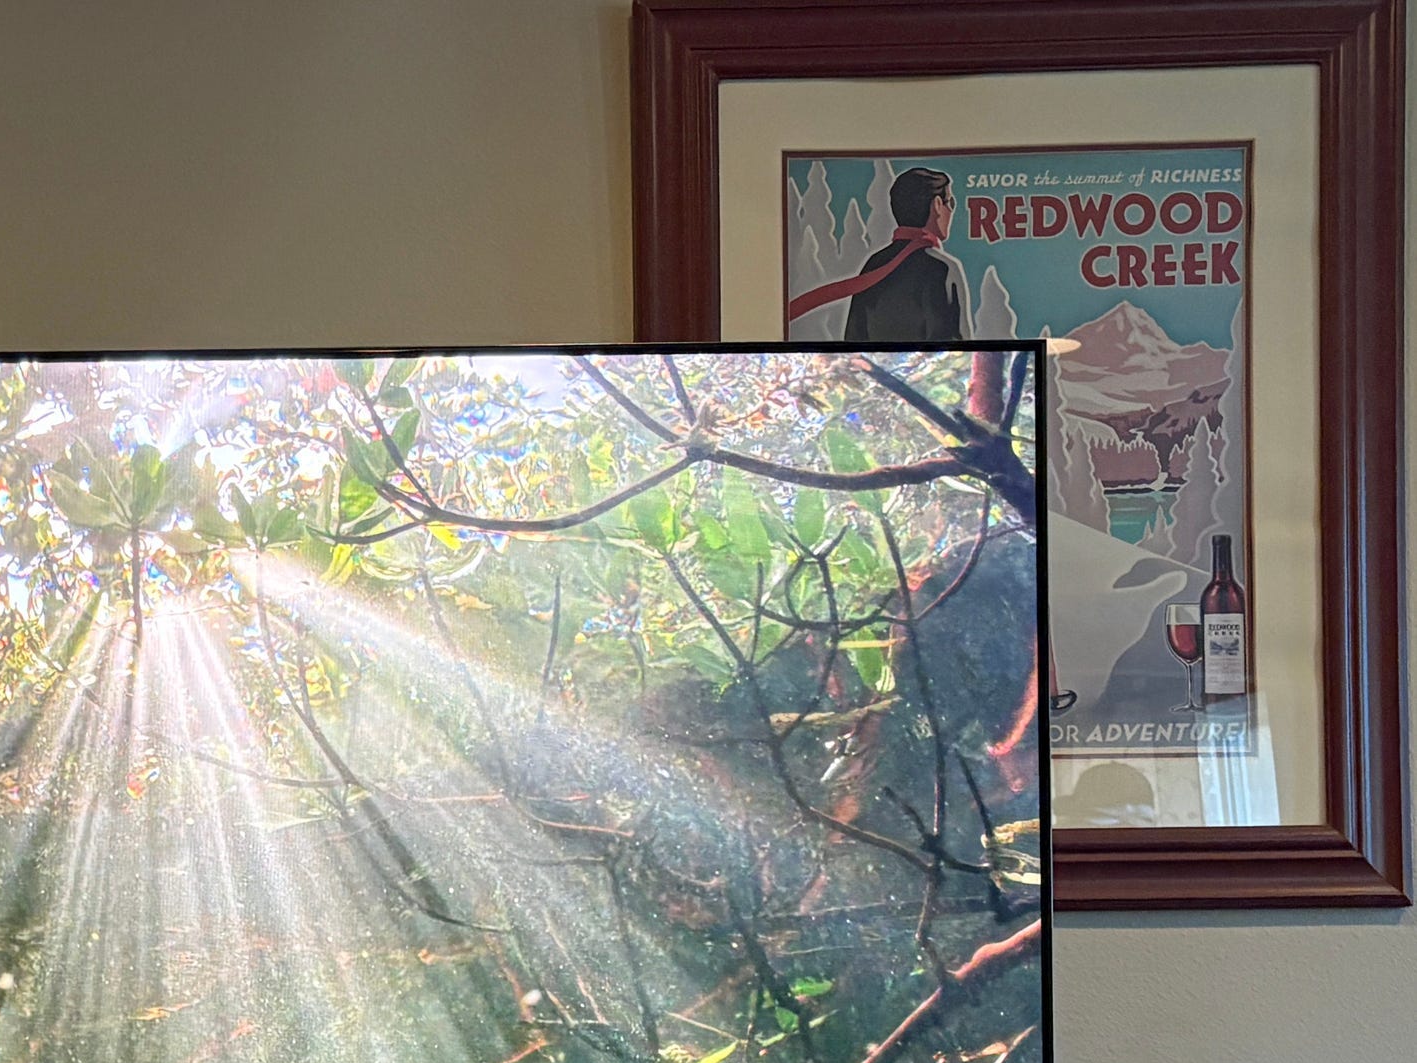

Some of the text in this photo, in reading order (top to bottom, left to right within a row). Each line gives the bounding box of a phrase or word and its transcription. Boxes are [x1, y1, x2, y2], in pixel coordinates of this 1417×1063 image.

[966, 168, 1243, 188] SAVOR the summit of RICHNESS
[965, 191, 1244, 244] REDWOOD
[1080, 240, 1241, 289] CREEK
